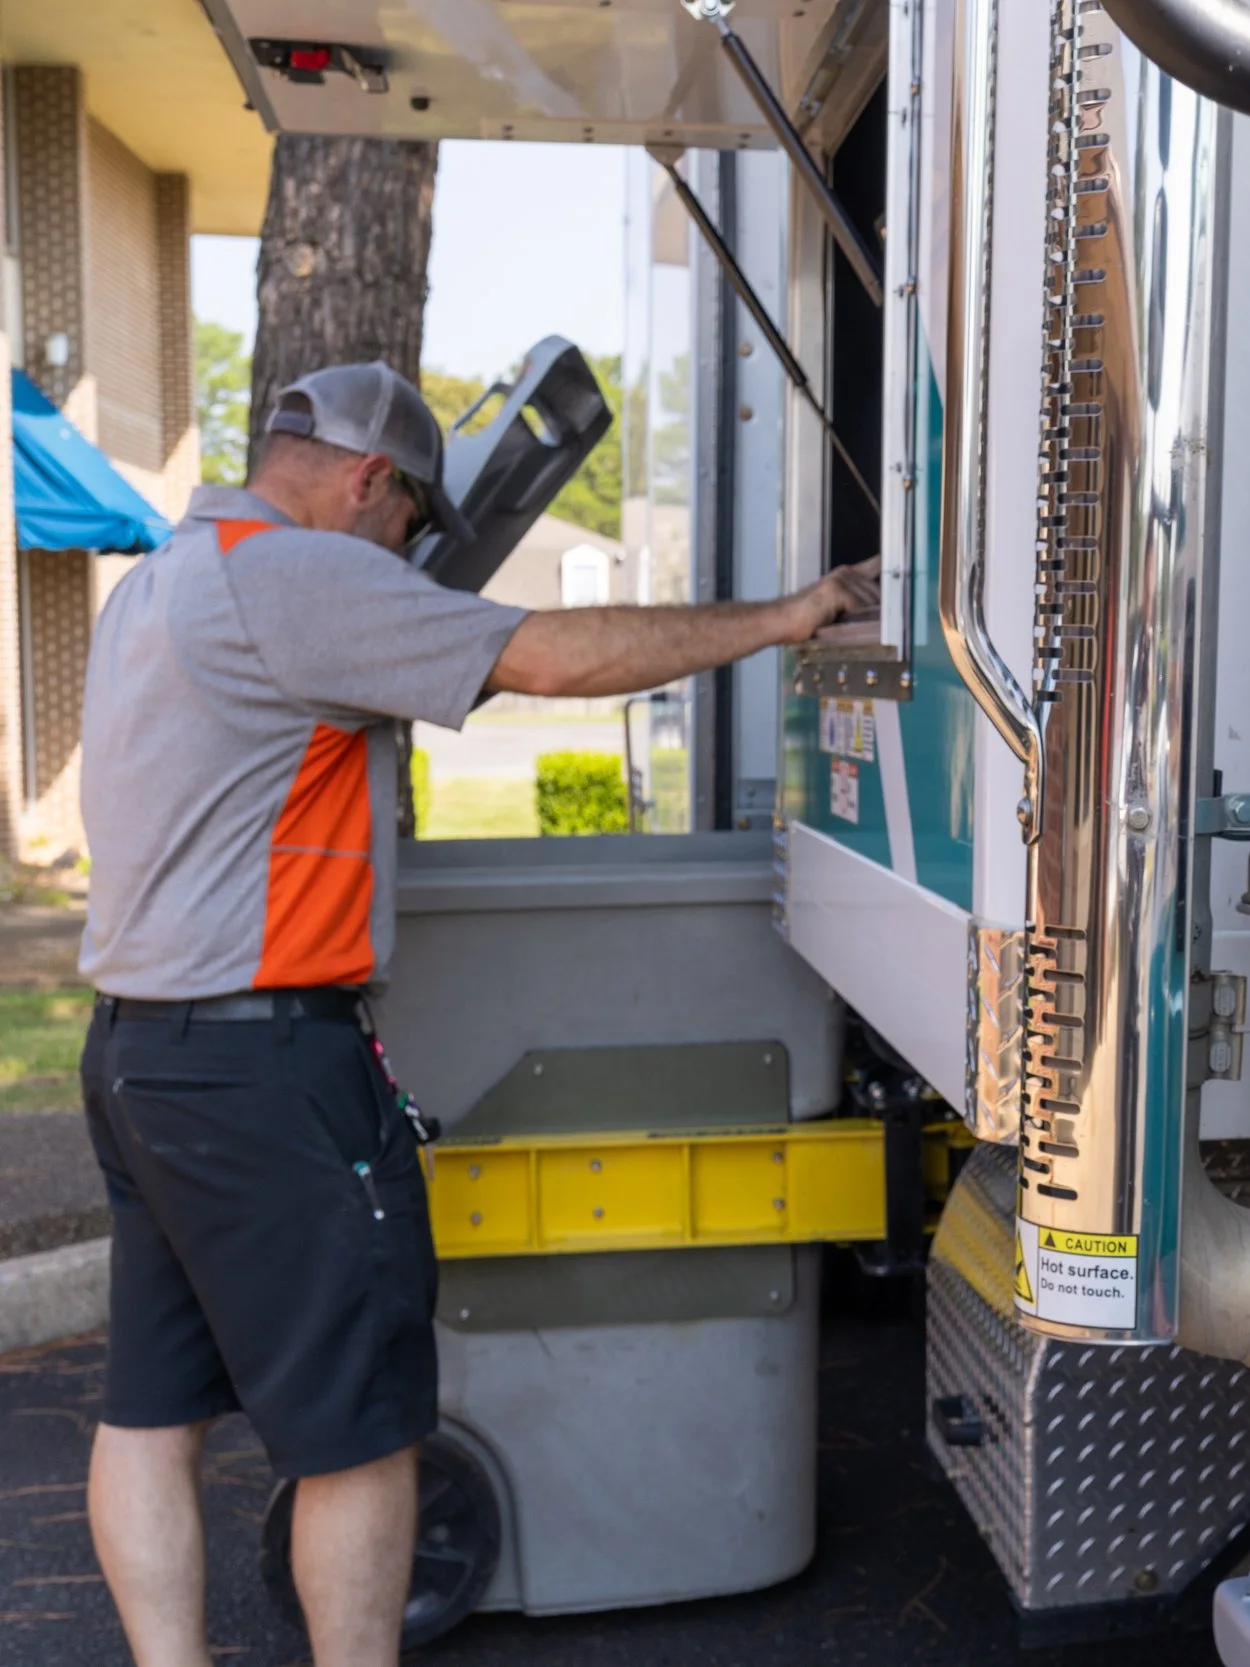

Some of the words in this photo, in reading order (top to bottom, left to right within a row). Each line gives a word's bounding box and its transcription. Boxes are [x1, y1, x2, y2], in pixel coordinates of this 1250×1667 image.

[1065, 1238, 1128, 1253] CAUTION
[1041, 1257, 1063, 1274] Hot
[1068, 1265, 1134, 1280] surface.
[1041, 1278, 1054, 1291] Do
[1058, 1283, 1077, 1295] not
[1082, 1286, 1125, 1299] touch.
